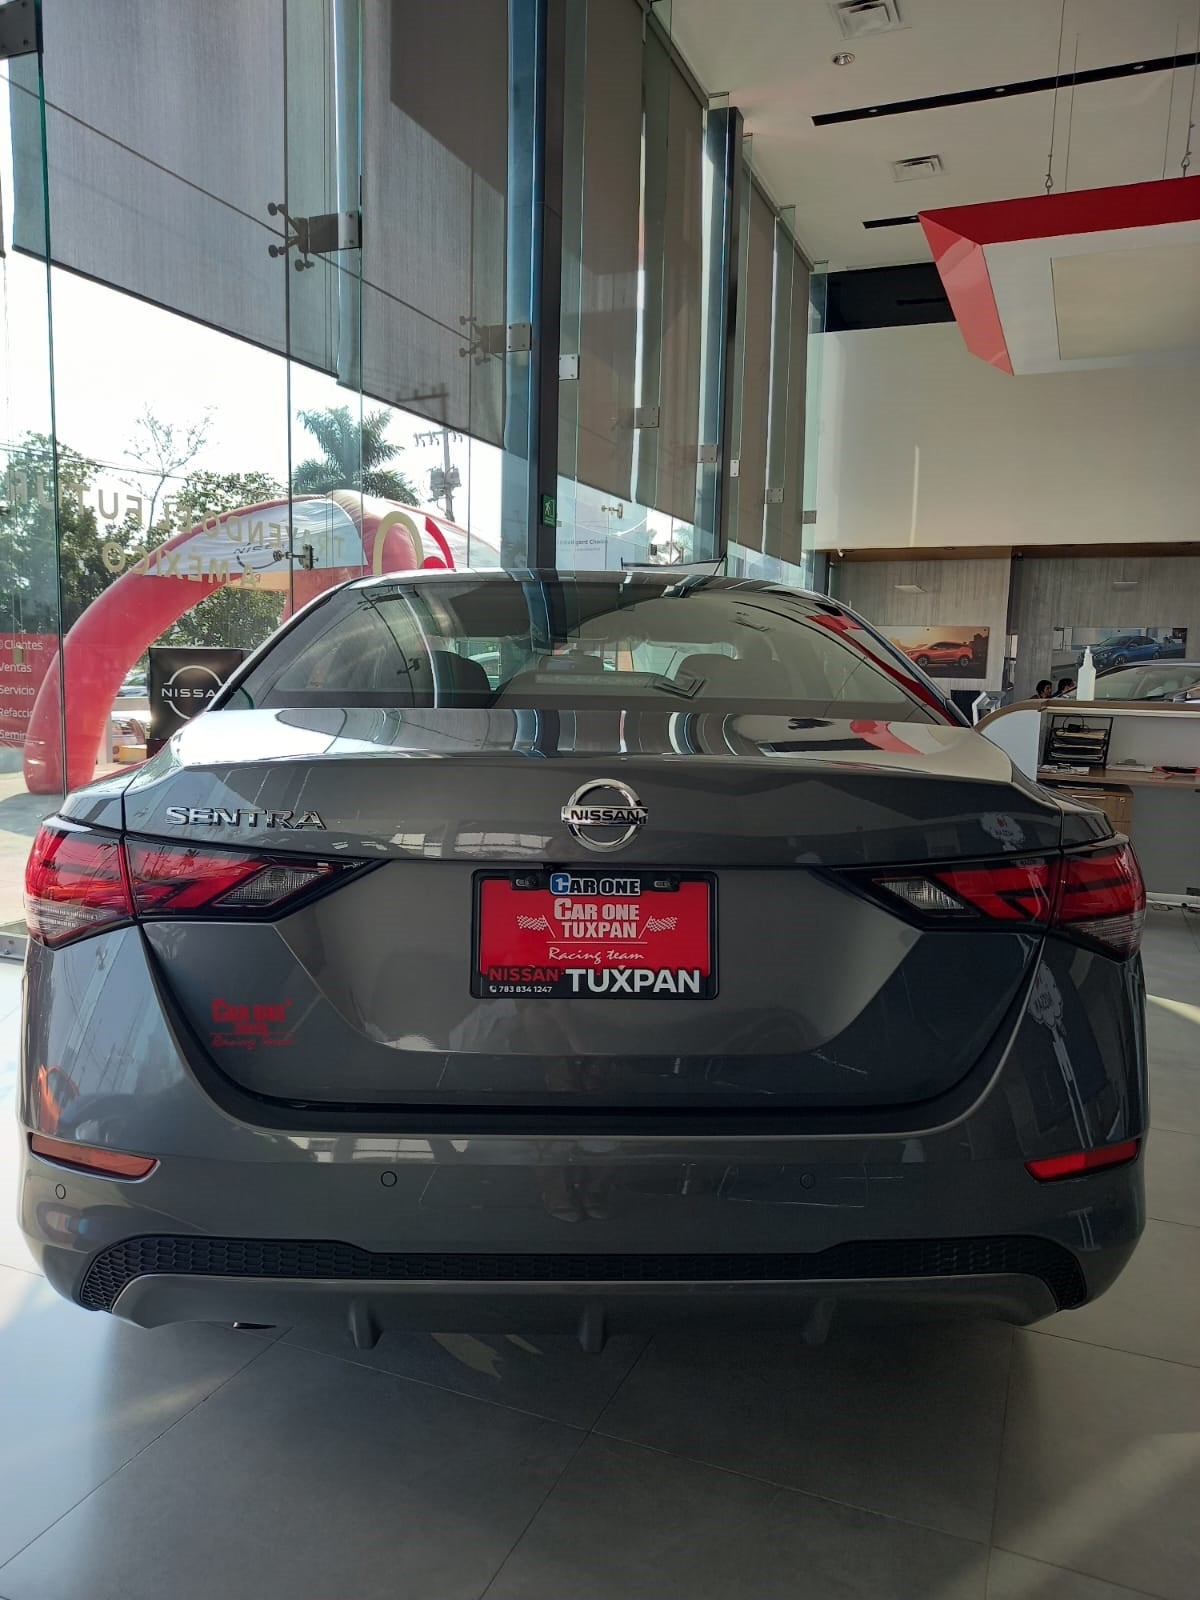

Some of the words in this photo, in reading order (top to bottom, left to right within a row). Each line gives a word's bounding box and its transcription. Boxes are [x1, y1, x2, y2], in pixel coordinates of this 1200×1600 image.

[4, 639, 44, 650] Clientes
[0, 685, 35, 696] Servicio
[161, 687, 216, 698] NISSA
[166, 806, 327, 830] SENTRA
[570, 809, 640, 822] NISSAN
[550, 872, 598, 896] CAR
[600, 878, 641, 896] ONE
[554, 898, 598, 921] CAR
[602, 904, 640, 921] ONE
[561, 921, 637, 938] TUXPAN
[549, 946, 601, 965] Racing
[606, 948, 645, 960] team
[488, 967, 560, 982] NISSAN
[565, 968, 700, 993] TUXPAN
[499, 985, 514, 993] 783
[516, 985, 532, 993] 834
[534, 985, 553, 993] 1247
